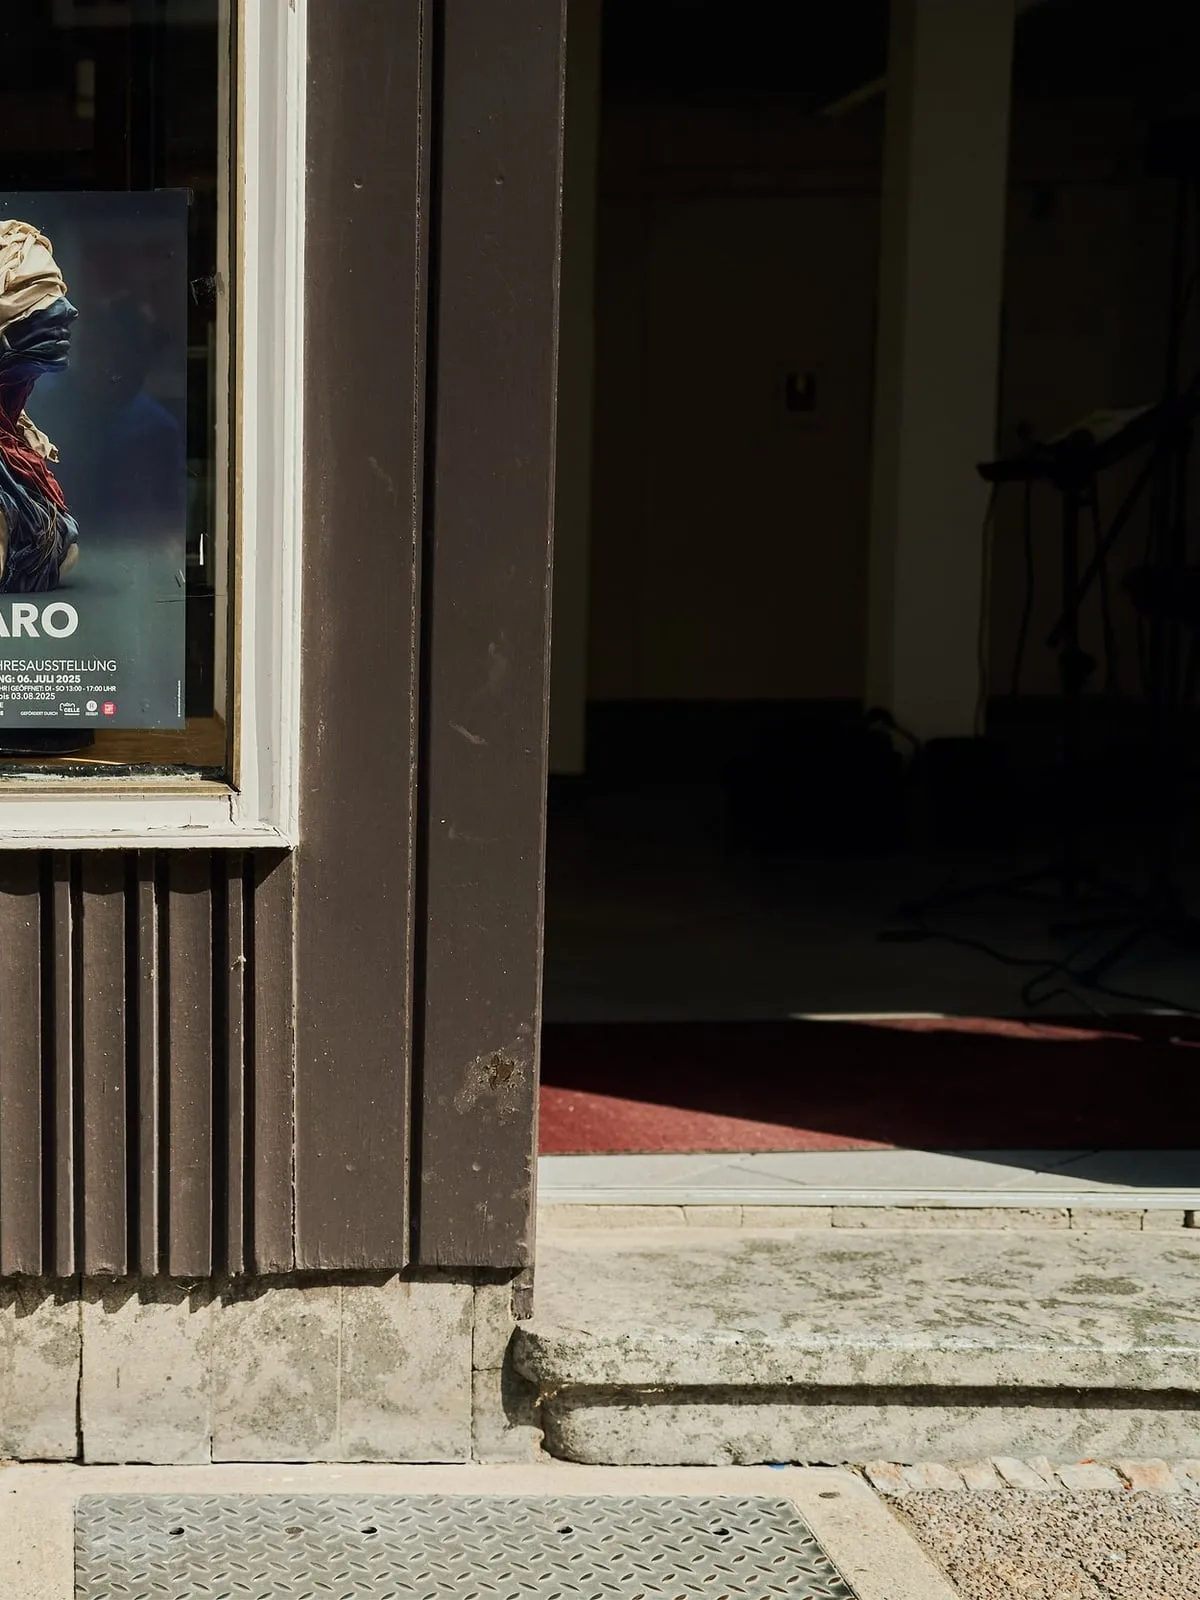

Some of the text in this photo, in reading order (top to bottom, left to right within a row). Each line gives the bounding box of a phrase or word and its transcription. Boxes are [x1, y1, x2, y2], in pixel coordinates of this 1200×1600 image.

[17, 674, 33, 683] 06.
[34, 674, 54, 683] JULI
[56, 674, 81, 683] 2025
[11, 692, 56, 700] 03.08.2025
